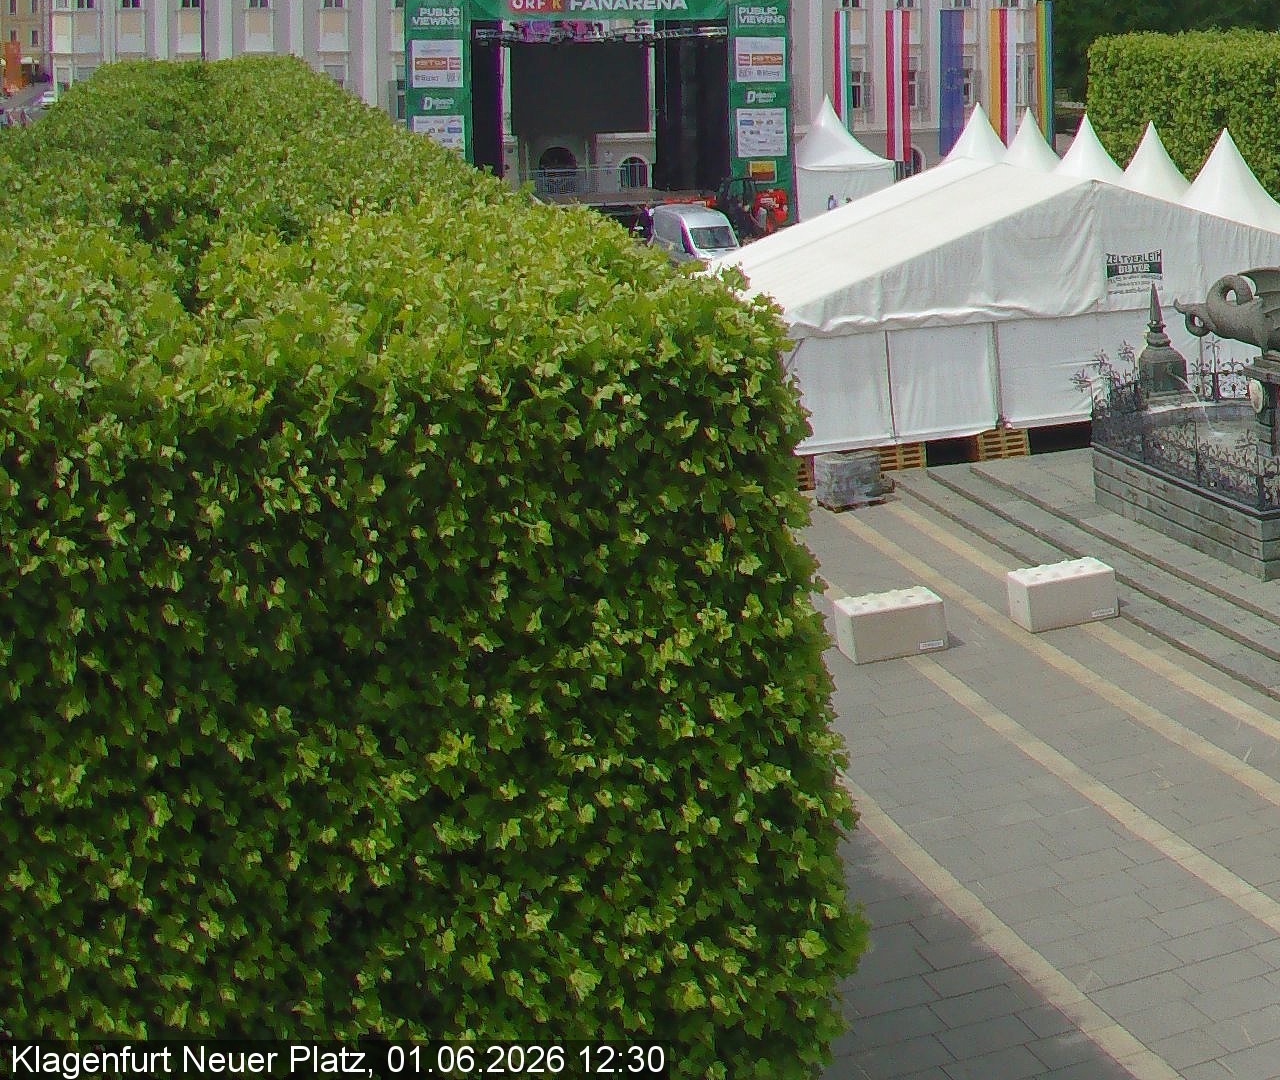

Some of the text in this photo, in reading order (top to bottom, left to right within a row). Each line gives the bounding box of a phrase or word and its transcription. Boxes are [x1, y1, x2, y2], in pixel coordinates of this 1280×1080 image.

[419, 7, 460, 16] PUBLIC
[739, 6, 779, 15] PUBLIC
[412, 16, 460, 26] VIEWING
[739, 14, 786, 24] VIEWING
[1105, 249, 1163, 265] ZELTVERLEIH
